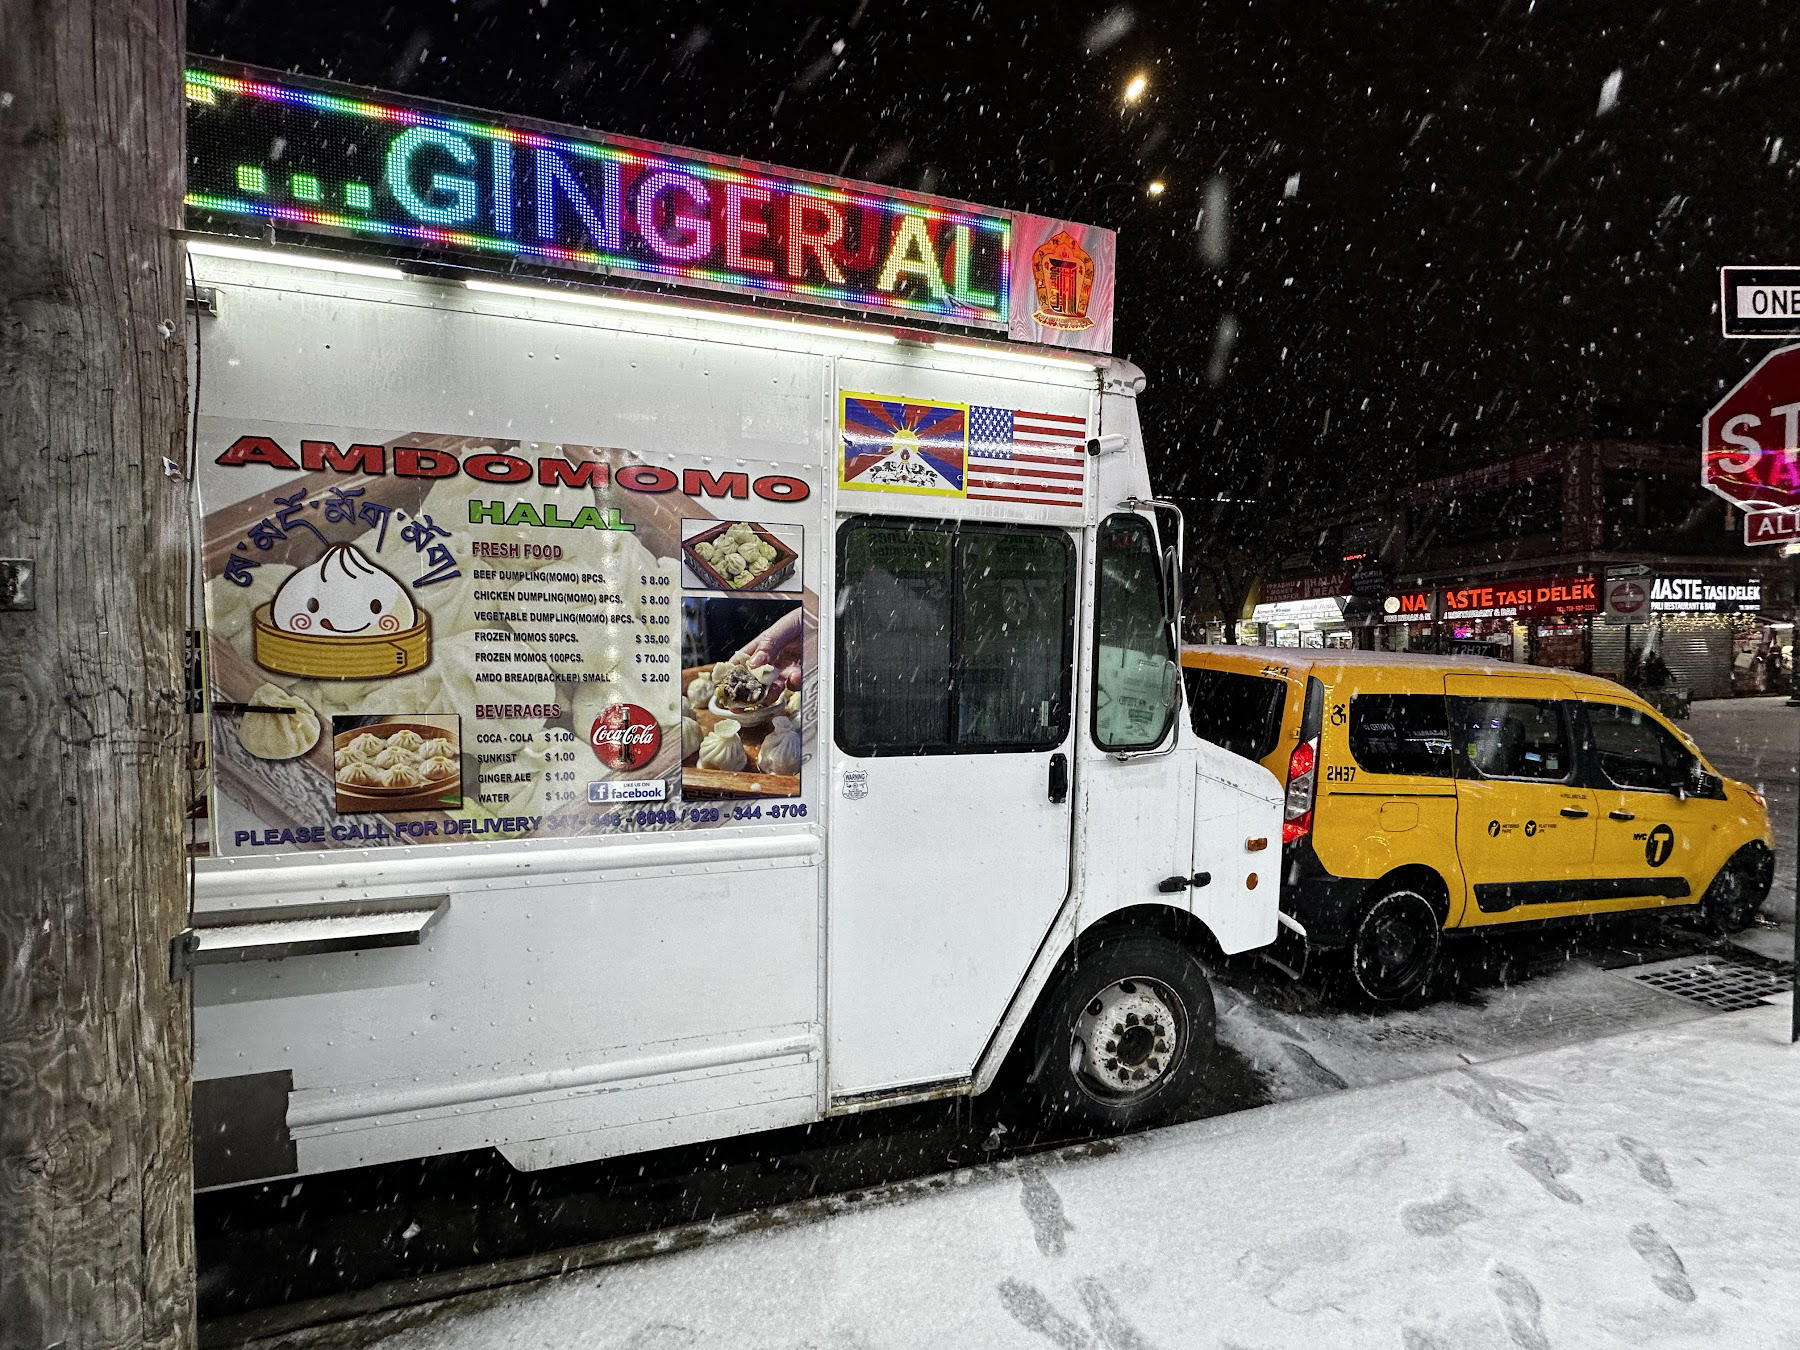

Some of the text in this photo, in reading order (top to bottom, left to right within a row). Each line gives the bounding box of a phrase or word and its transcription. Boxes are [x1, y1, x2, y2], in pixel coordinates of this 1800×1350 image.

[877, 213, 997, 307] AL
[1752, 290, 1800, 315] ONE
[215, 435, 810, 503] AMDOMOMO
[468, 500, 636, 532] HALAL
[472, 541, 563, 559] FRESH FOOD
[473, 570, 670, 586] BEEF DUMPLING(MOMO) 8PCS. $ 8.00
[474, 591, 670, 605] CHICKEN DUMPLING(MOMO) 8PCS. $ 8.00
[1497, 590, 1532, 605] TASI
[1536, 583, 1596, 603] DELEK
[1703, 586, 1727, 600] TASI
[1728, 586, 1761, 600] DELEK
[1664, 602, 1700, 611] RESTAURANT
[1705, 602, 1716, 611] BAR
[474, 611, 670, 625] VEGETABLE DUMPLING(MOMO) 8PCS. $ 8.00
[475, 632, 670, 644] FROZEN MOMOS 50PCS. $ 35.00
[475, 652, 670, 664] FROZEN MOMOS 100PCS. $ 70.00
[475, 673, 502, 683] AMDO
[641, 673, 648, 683] $
[650, 674, 670, 683] 2.00
[475, 703, 561, 719] BEVERAGES
[477, 733, 502, 743] COCA
[509, 733, 534, 743] COLA
[544, 733, 551, 743] $
[554, 732, 575, 743] 1.00
[477, 752, 575, 763] SUNKIST $ 1.00
[478, 772, 575, 783] GINGER ALE $ 1.00
[1327, 765, 1356, 782] 2H37
[478, 791, 575, 803] WATER $ 1.00
[611, 787, 662, 799] facebook
[235, 826, 326, 847] PLEASE
[331, 823, 390, 841] CALL
[395, 820, 440, 838] FOR
[443, 815, 542, 836] DELIVERY
[690, 807, 719, 823] 929
[734, 805, 762, 821] 344
[1633, 833, 1648, 841] NYC
[1653, 832, 1670, 863] T
